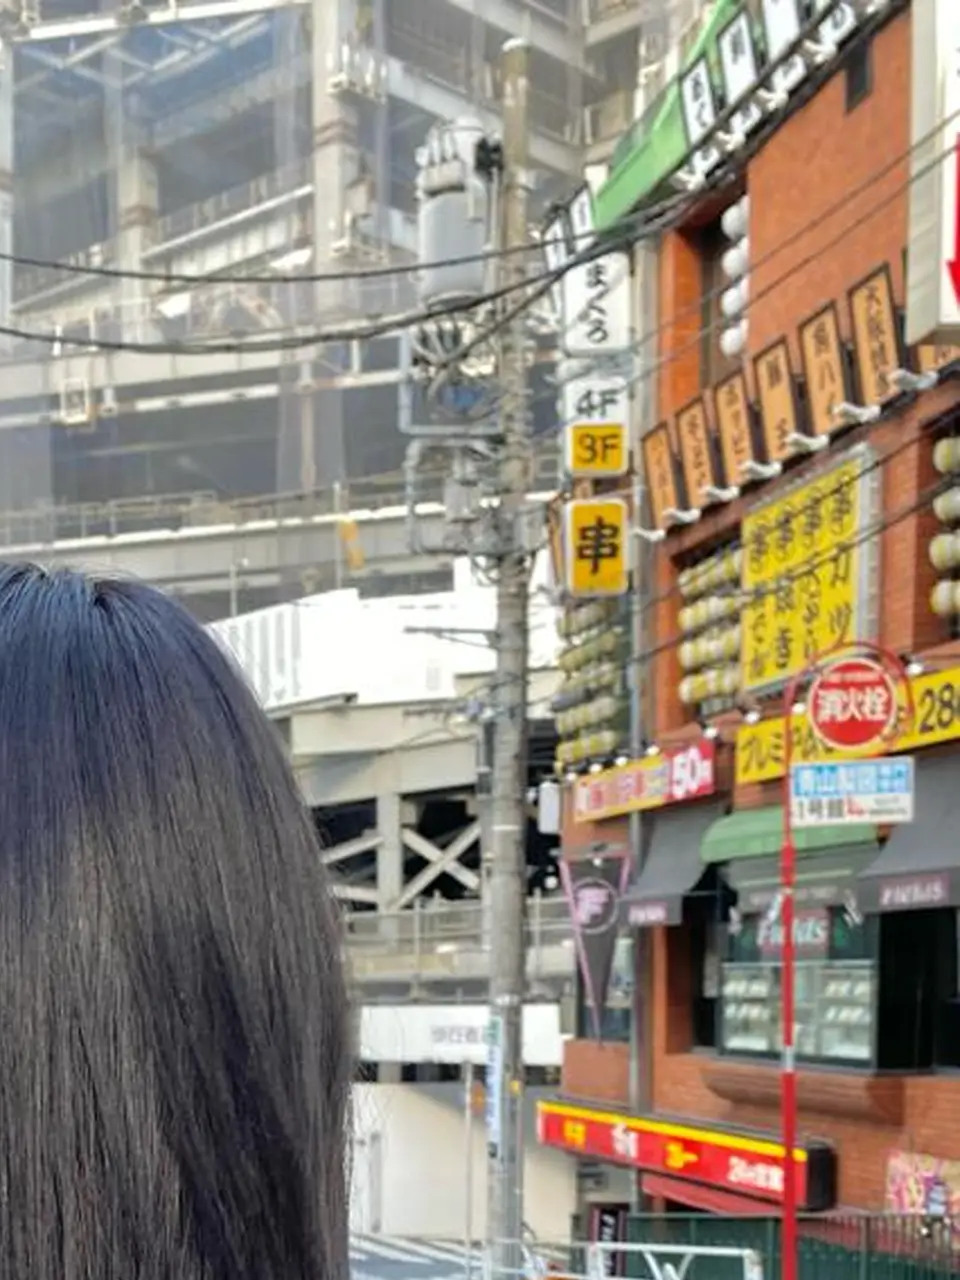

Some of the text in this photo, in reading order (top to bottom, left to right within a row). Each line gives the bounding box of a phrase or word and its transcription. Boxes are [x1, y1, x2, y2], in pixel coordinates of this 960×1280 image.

[577, 435, 620, 463] 3F
[577, 516, 619, 575] 串
[818, 687, 888, 723] 消火栓
